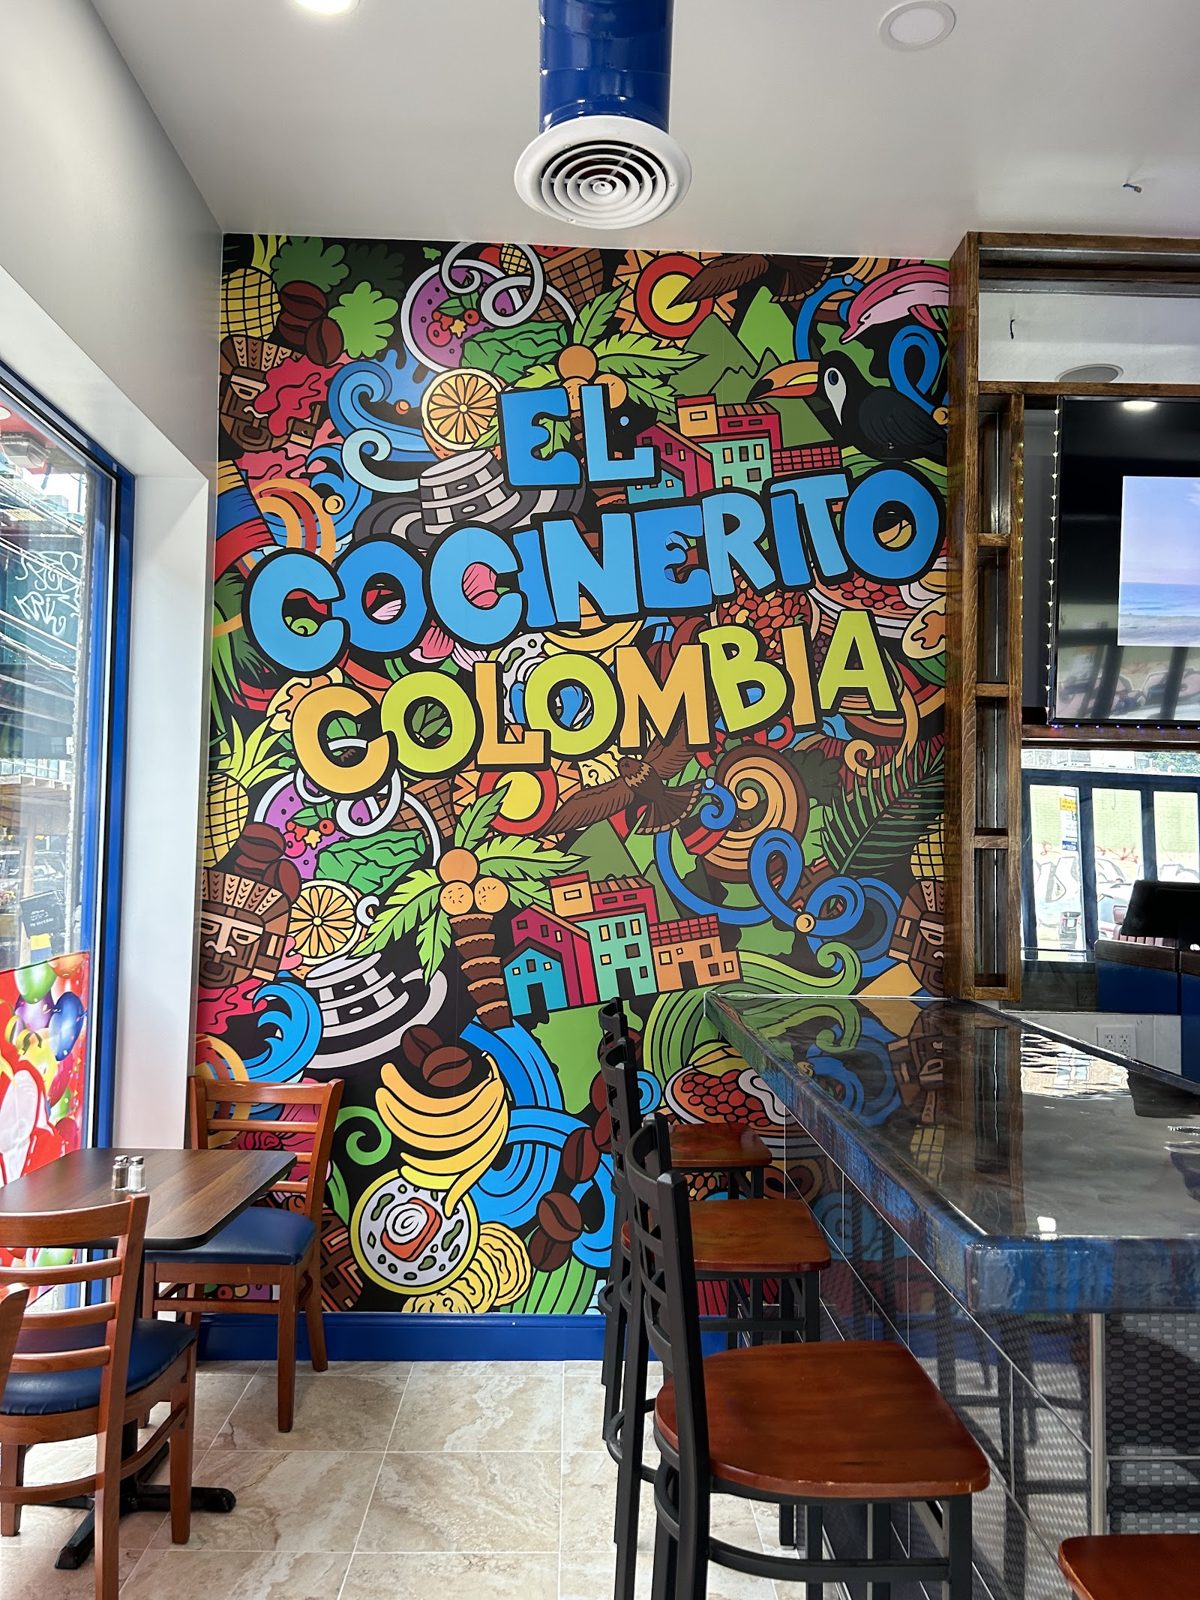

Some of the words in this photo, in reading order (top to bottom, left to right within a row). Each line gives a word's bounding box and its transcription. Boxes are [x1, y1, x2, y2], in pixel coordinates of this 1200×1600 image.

[501, 384, 654, 486] EL
[249, 469, 939, 671] COCINERITO
[295, 611, 897, 794] COLOMBIA
